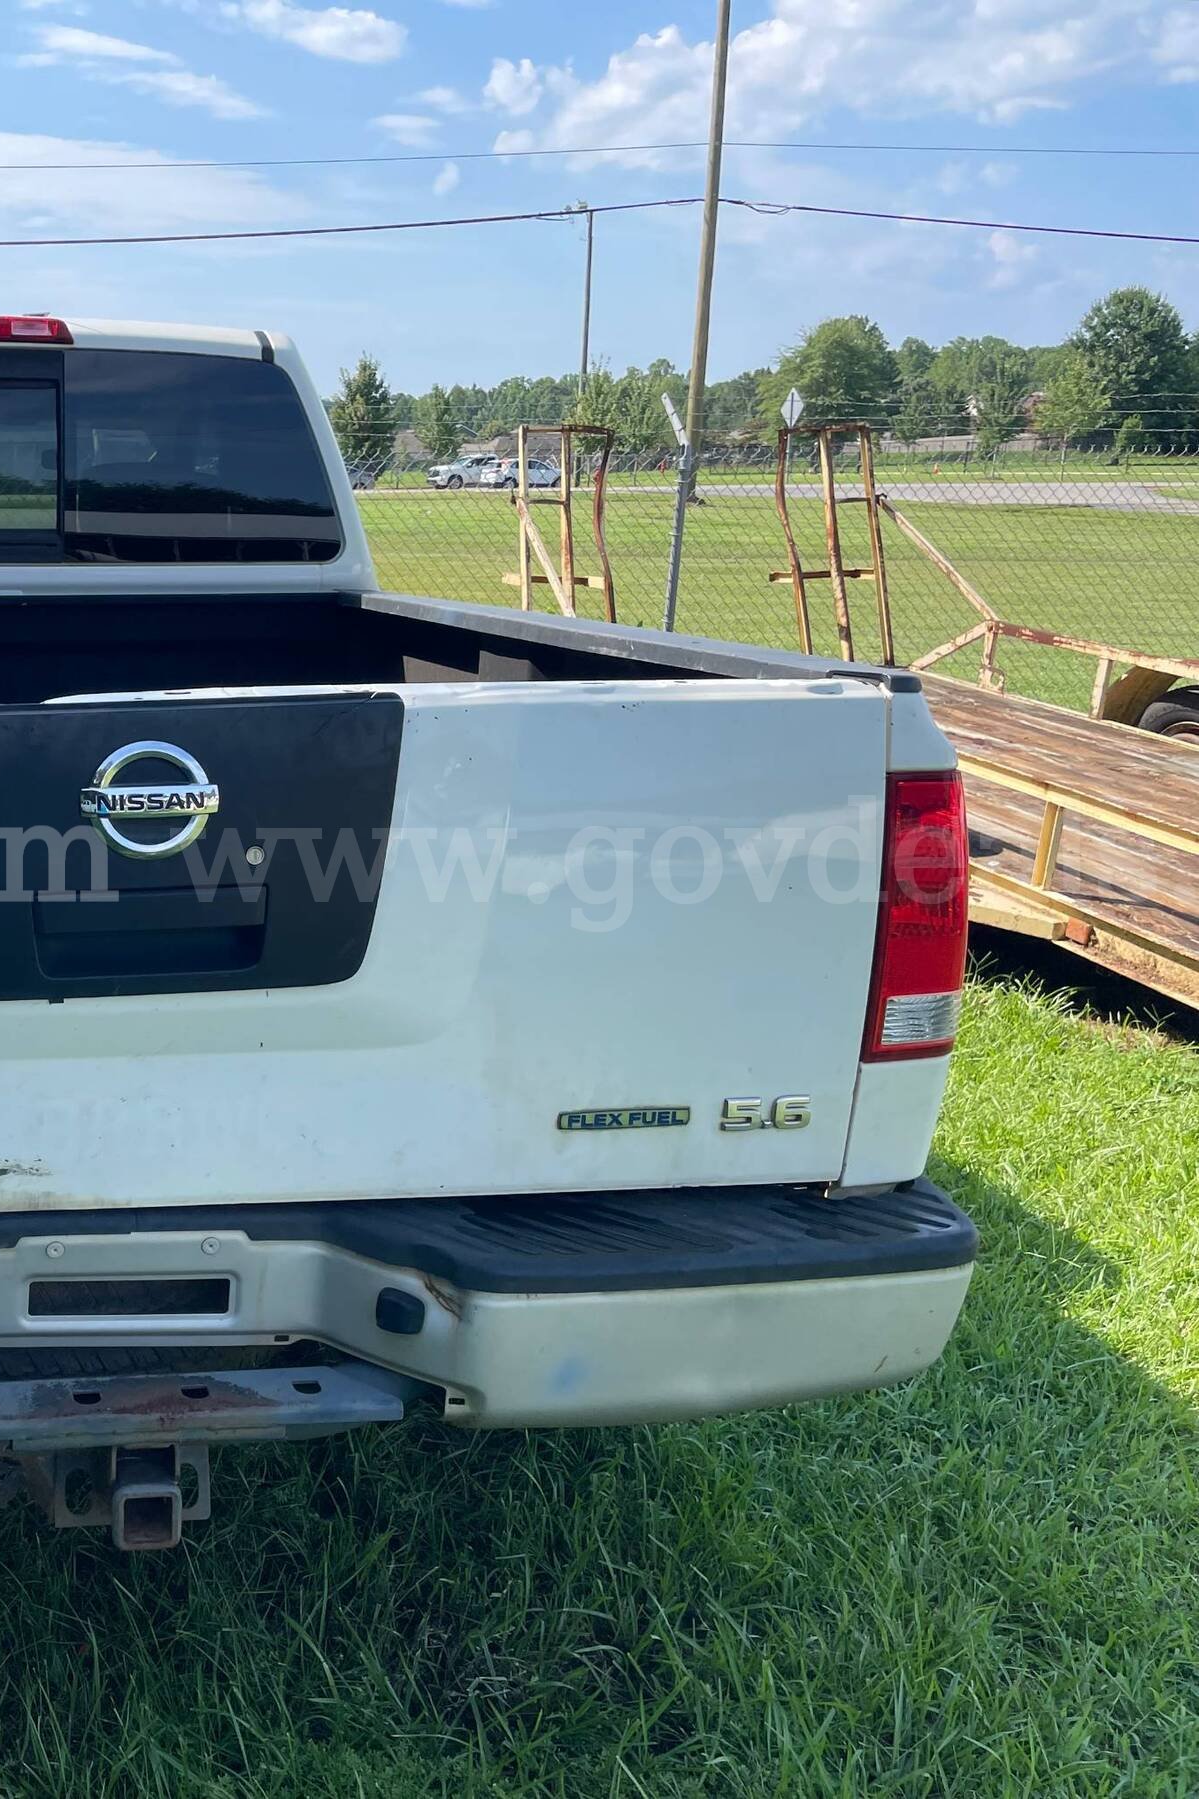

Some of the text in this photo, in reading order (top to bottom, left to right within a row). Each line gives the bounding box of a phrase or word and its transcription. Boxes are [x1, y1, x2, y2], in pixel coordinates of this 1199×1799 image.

[96, 791, 206, 813] NISSAN
[567, 1110, 685, 1129] FLEX FUEL
[720, 1095, 812, 1131] 5.6
